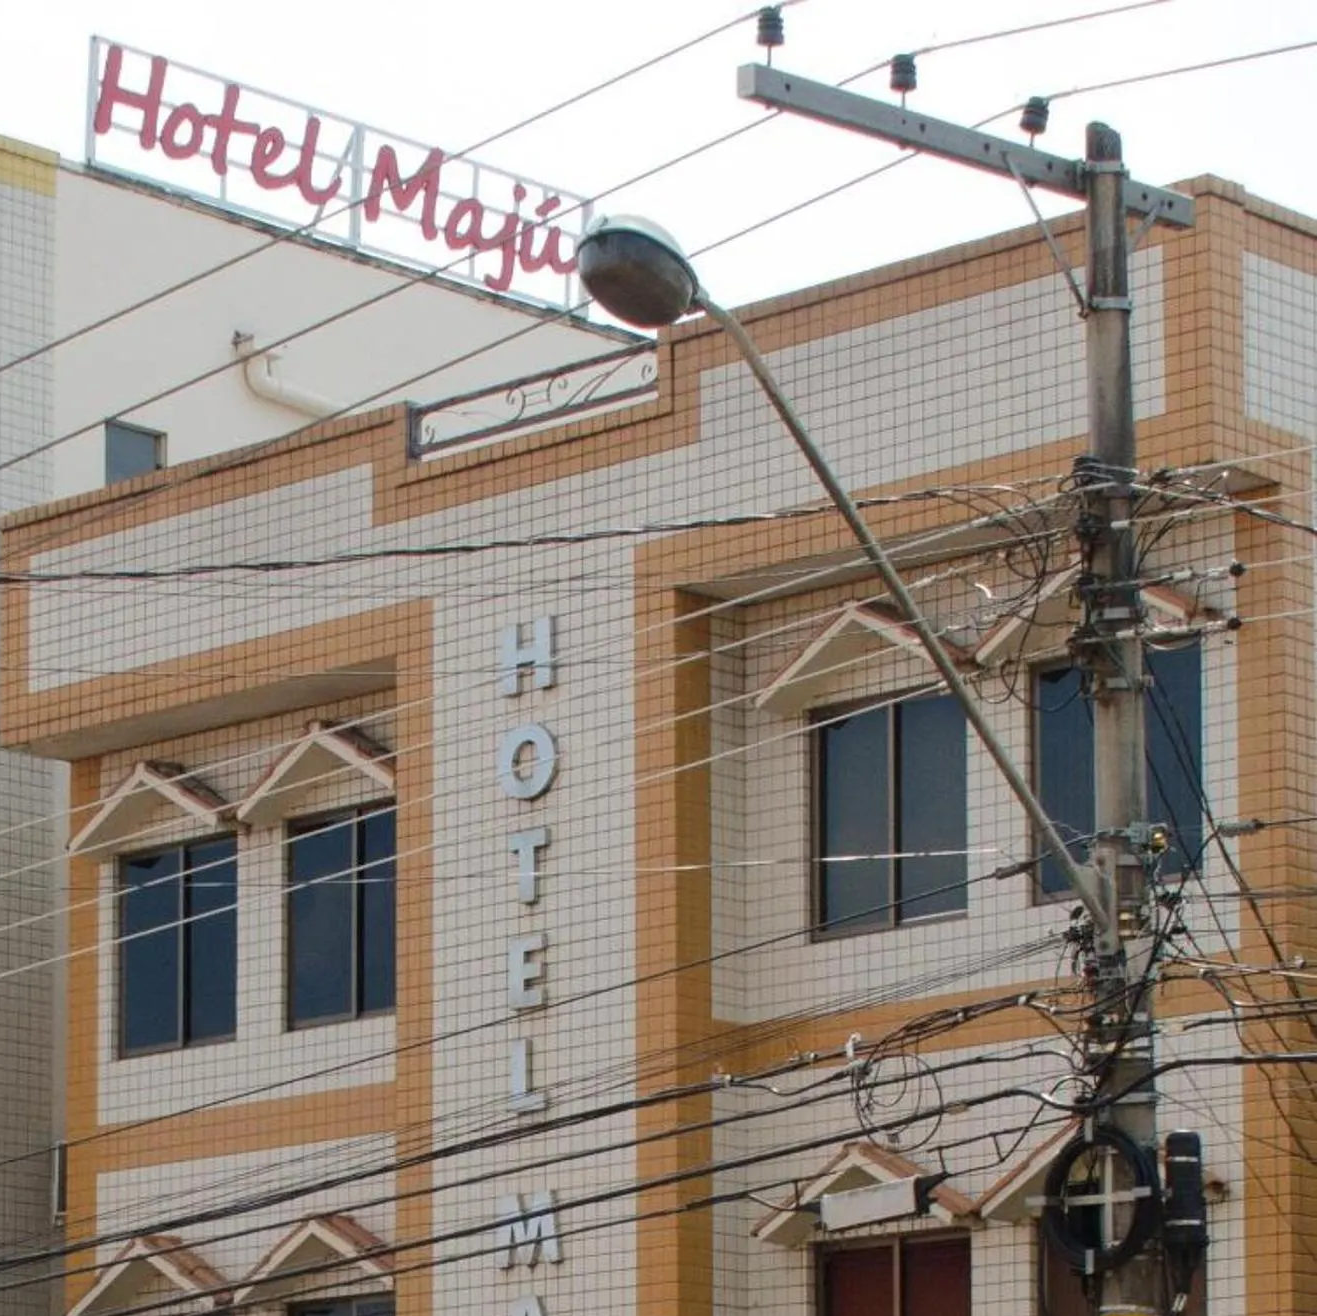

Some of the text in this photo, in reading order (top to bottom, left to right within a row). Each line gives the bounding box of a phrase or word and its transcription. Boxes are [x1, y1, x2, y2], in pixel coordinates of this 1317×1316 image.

[93, 44, 578, 291] Hotel Majú
[498, 614, 559, 1114] HOTEL
